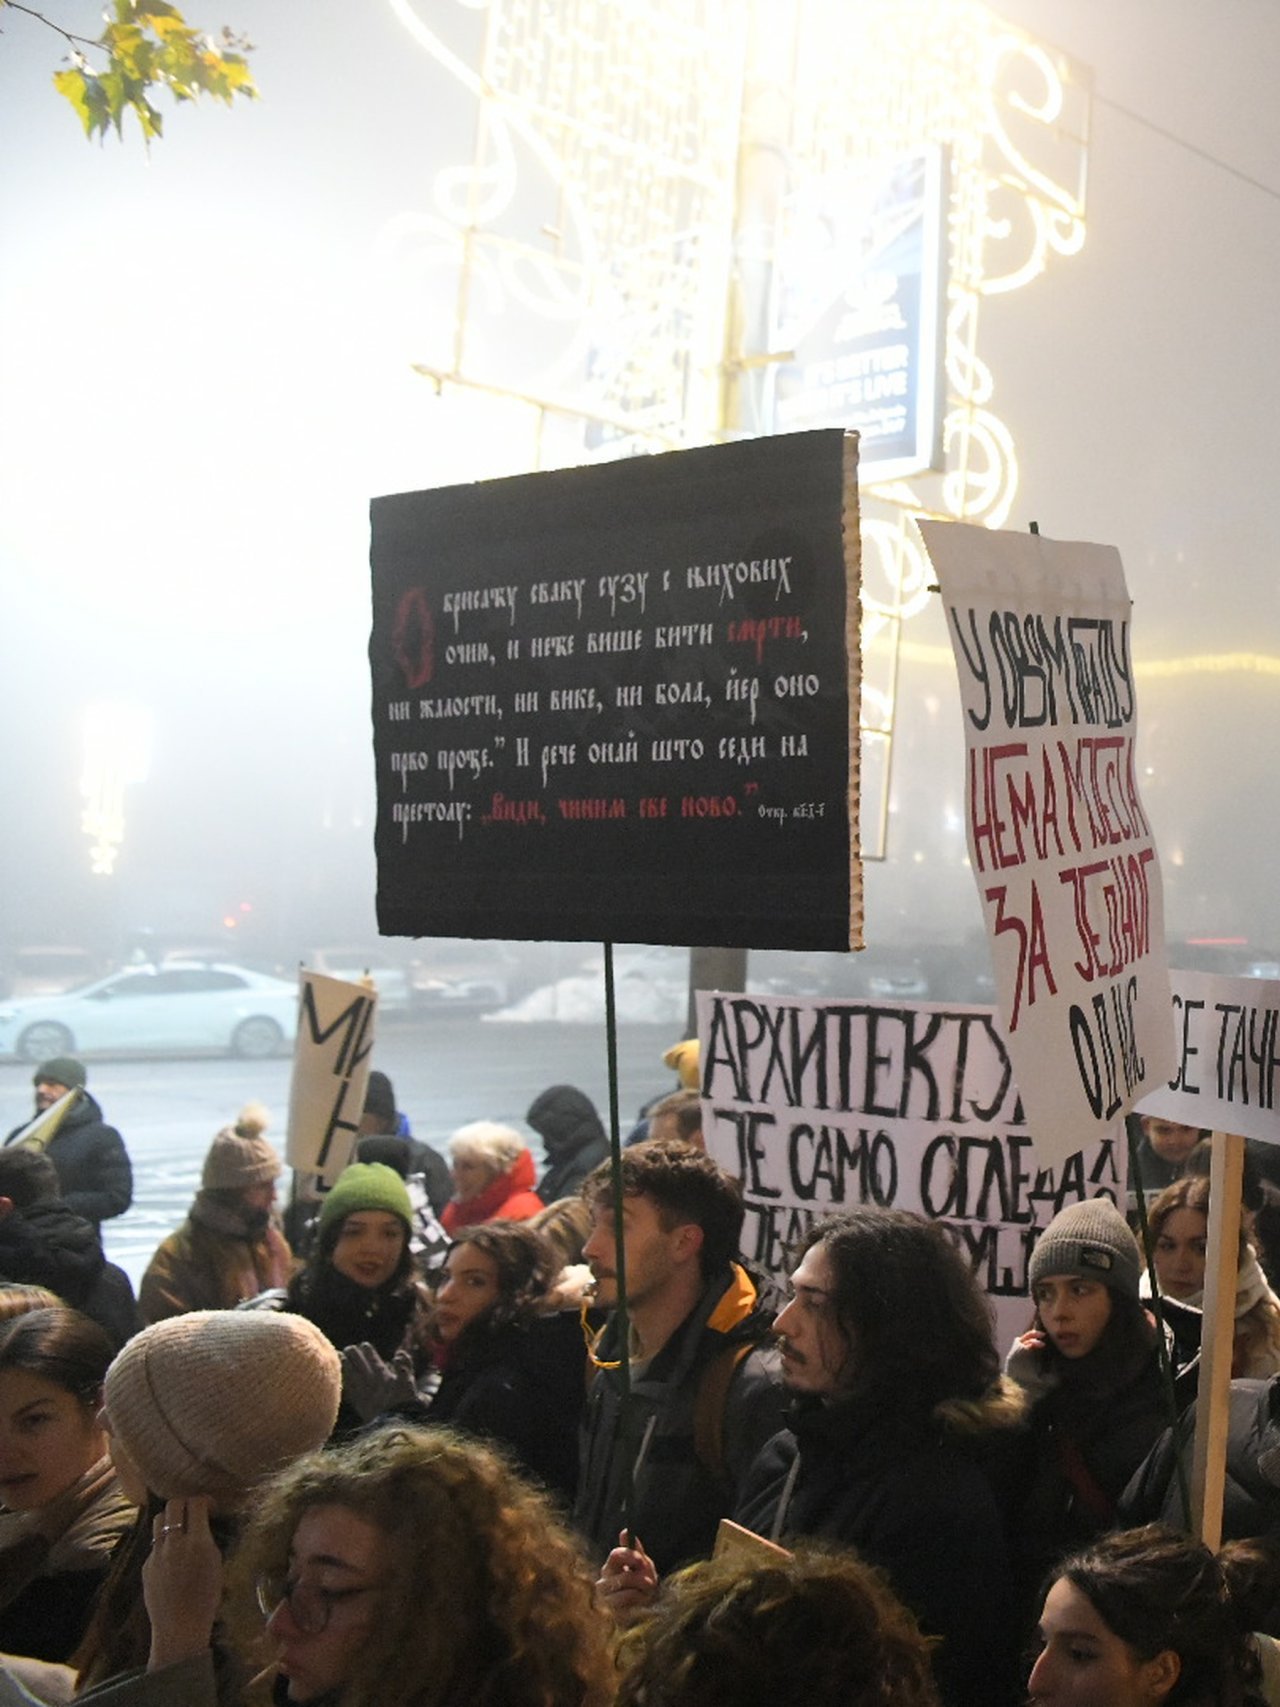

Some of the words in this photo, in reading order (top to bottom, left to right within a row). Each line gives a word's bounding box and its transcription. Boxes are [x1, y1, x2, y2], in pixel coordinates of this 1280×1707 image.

[969, 742, 1066, 872] НЕМА
[985, 879, 1058, 1034] ЗА
[699, 998, 1027, 1125] АРХИТЕКТУ
[788, 1124, 898, 1203] САМО
